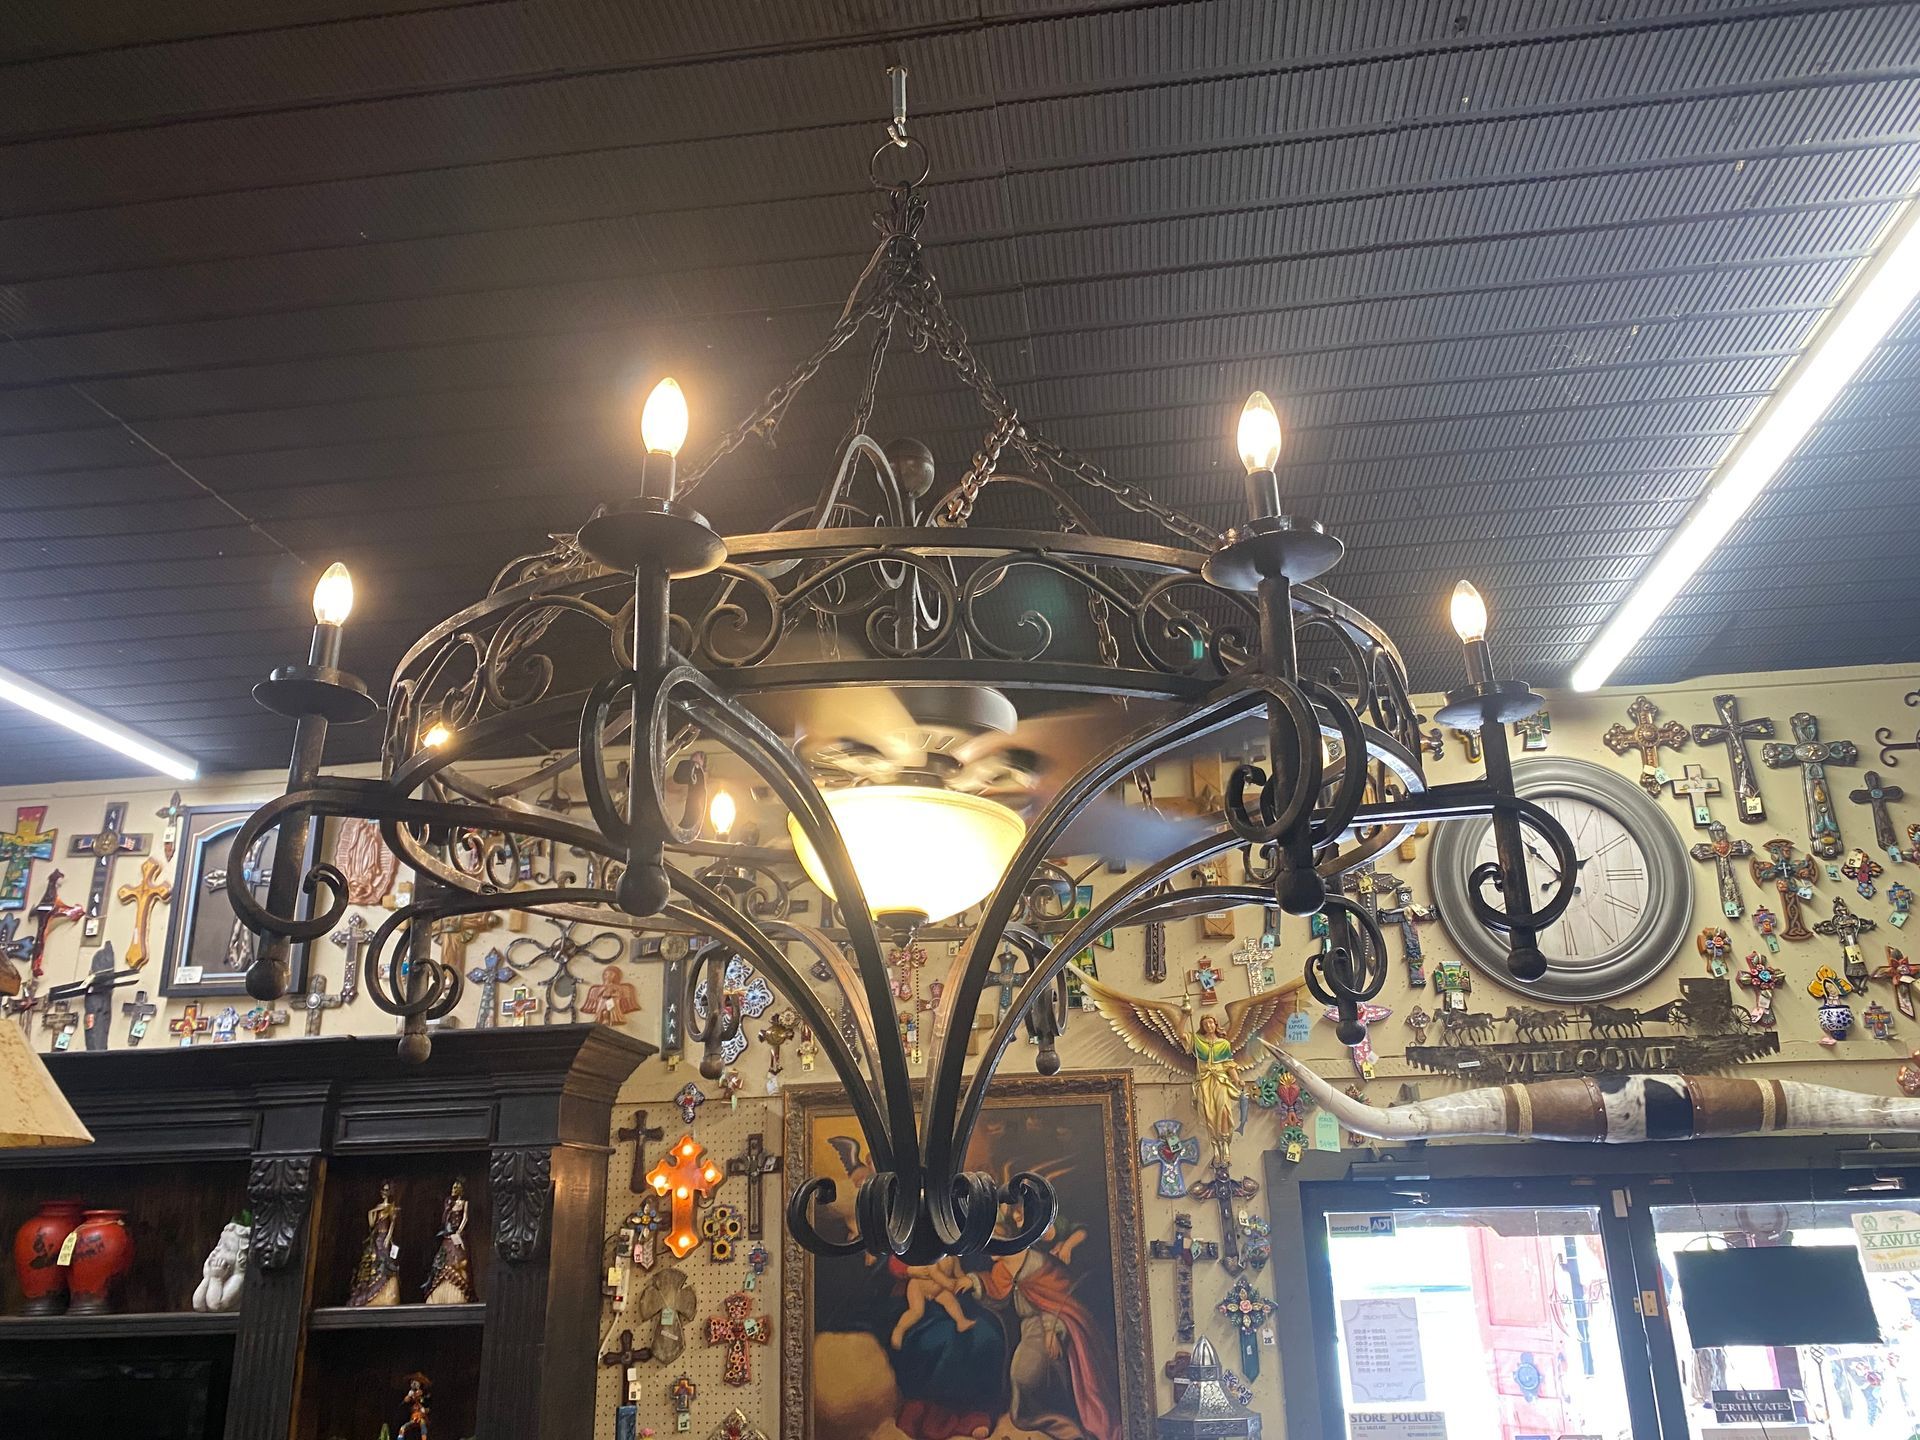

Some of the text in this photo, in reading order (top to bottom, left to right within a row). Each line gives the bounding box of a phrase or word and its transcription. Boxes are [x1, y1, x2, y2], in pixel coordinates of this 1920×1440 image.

[1497, 1046, 1676, 1073] WELCOME
[1372, 1219, 1391, 1231] ADT
[1714, 1402, 1791, 1412] CERTIFICATES
[1350, 1412, 1442, 1423] STORE POLICIES
[1724, 1413, 1785, 1422] AVAILABLE
